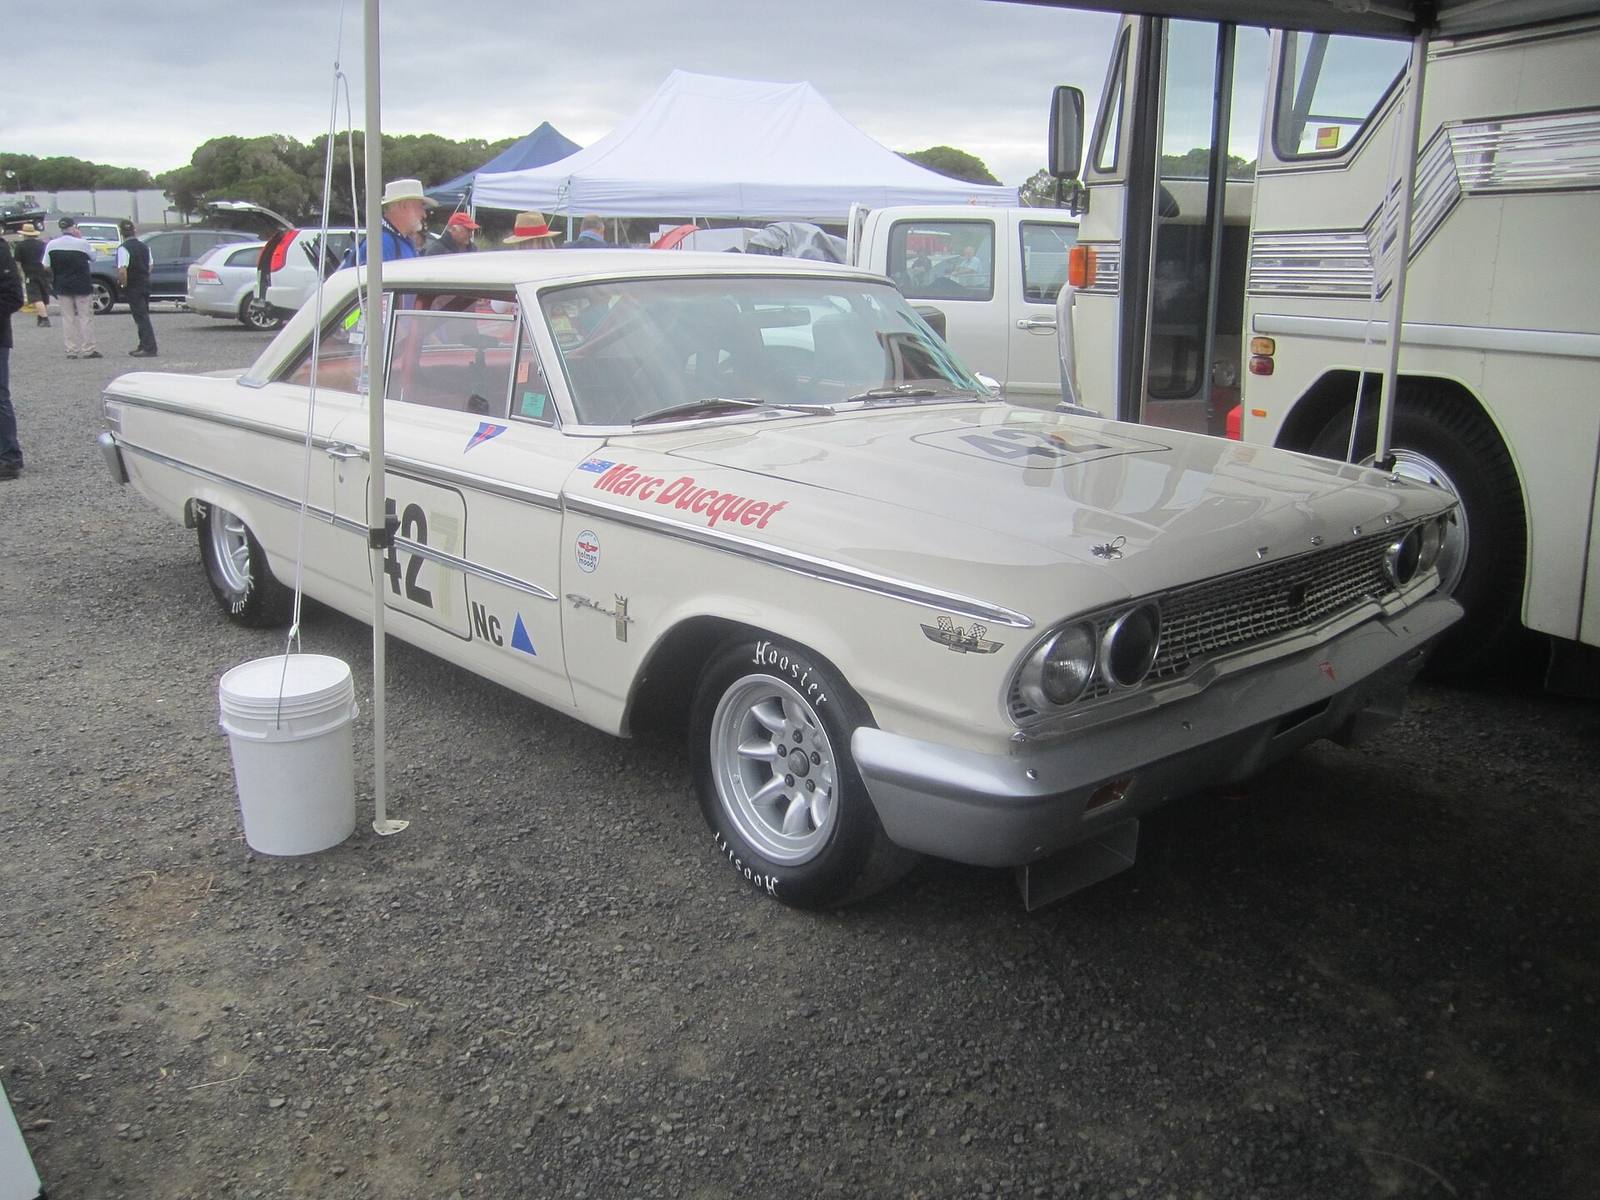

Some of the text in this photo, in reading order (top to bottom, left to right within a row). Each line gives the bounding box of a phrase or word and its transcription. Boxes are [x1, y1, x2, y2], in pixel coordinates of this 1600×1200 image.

[593, 463, 789, 529] Marc Ducquet
[753, 640, 827, 705] Hoosier
